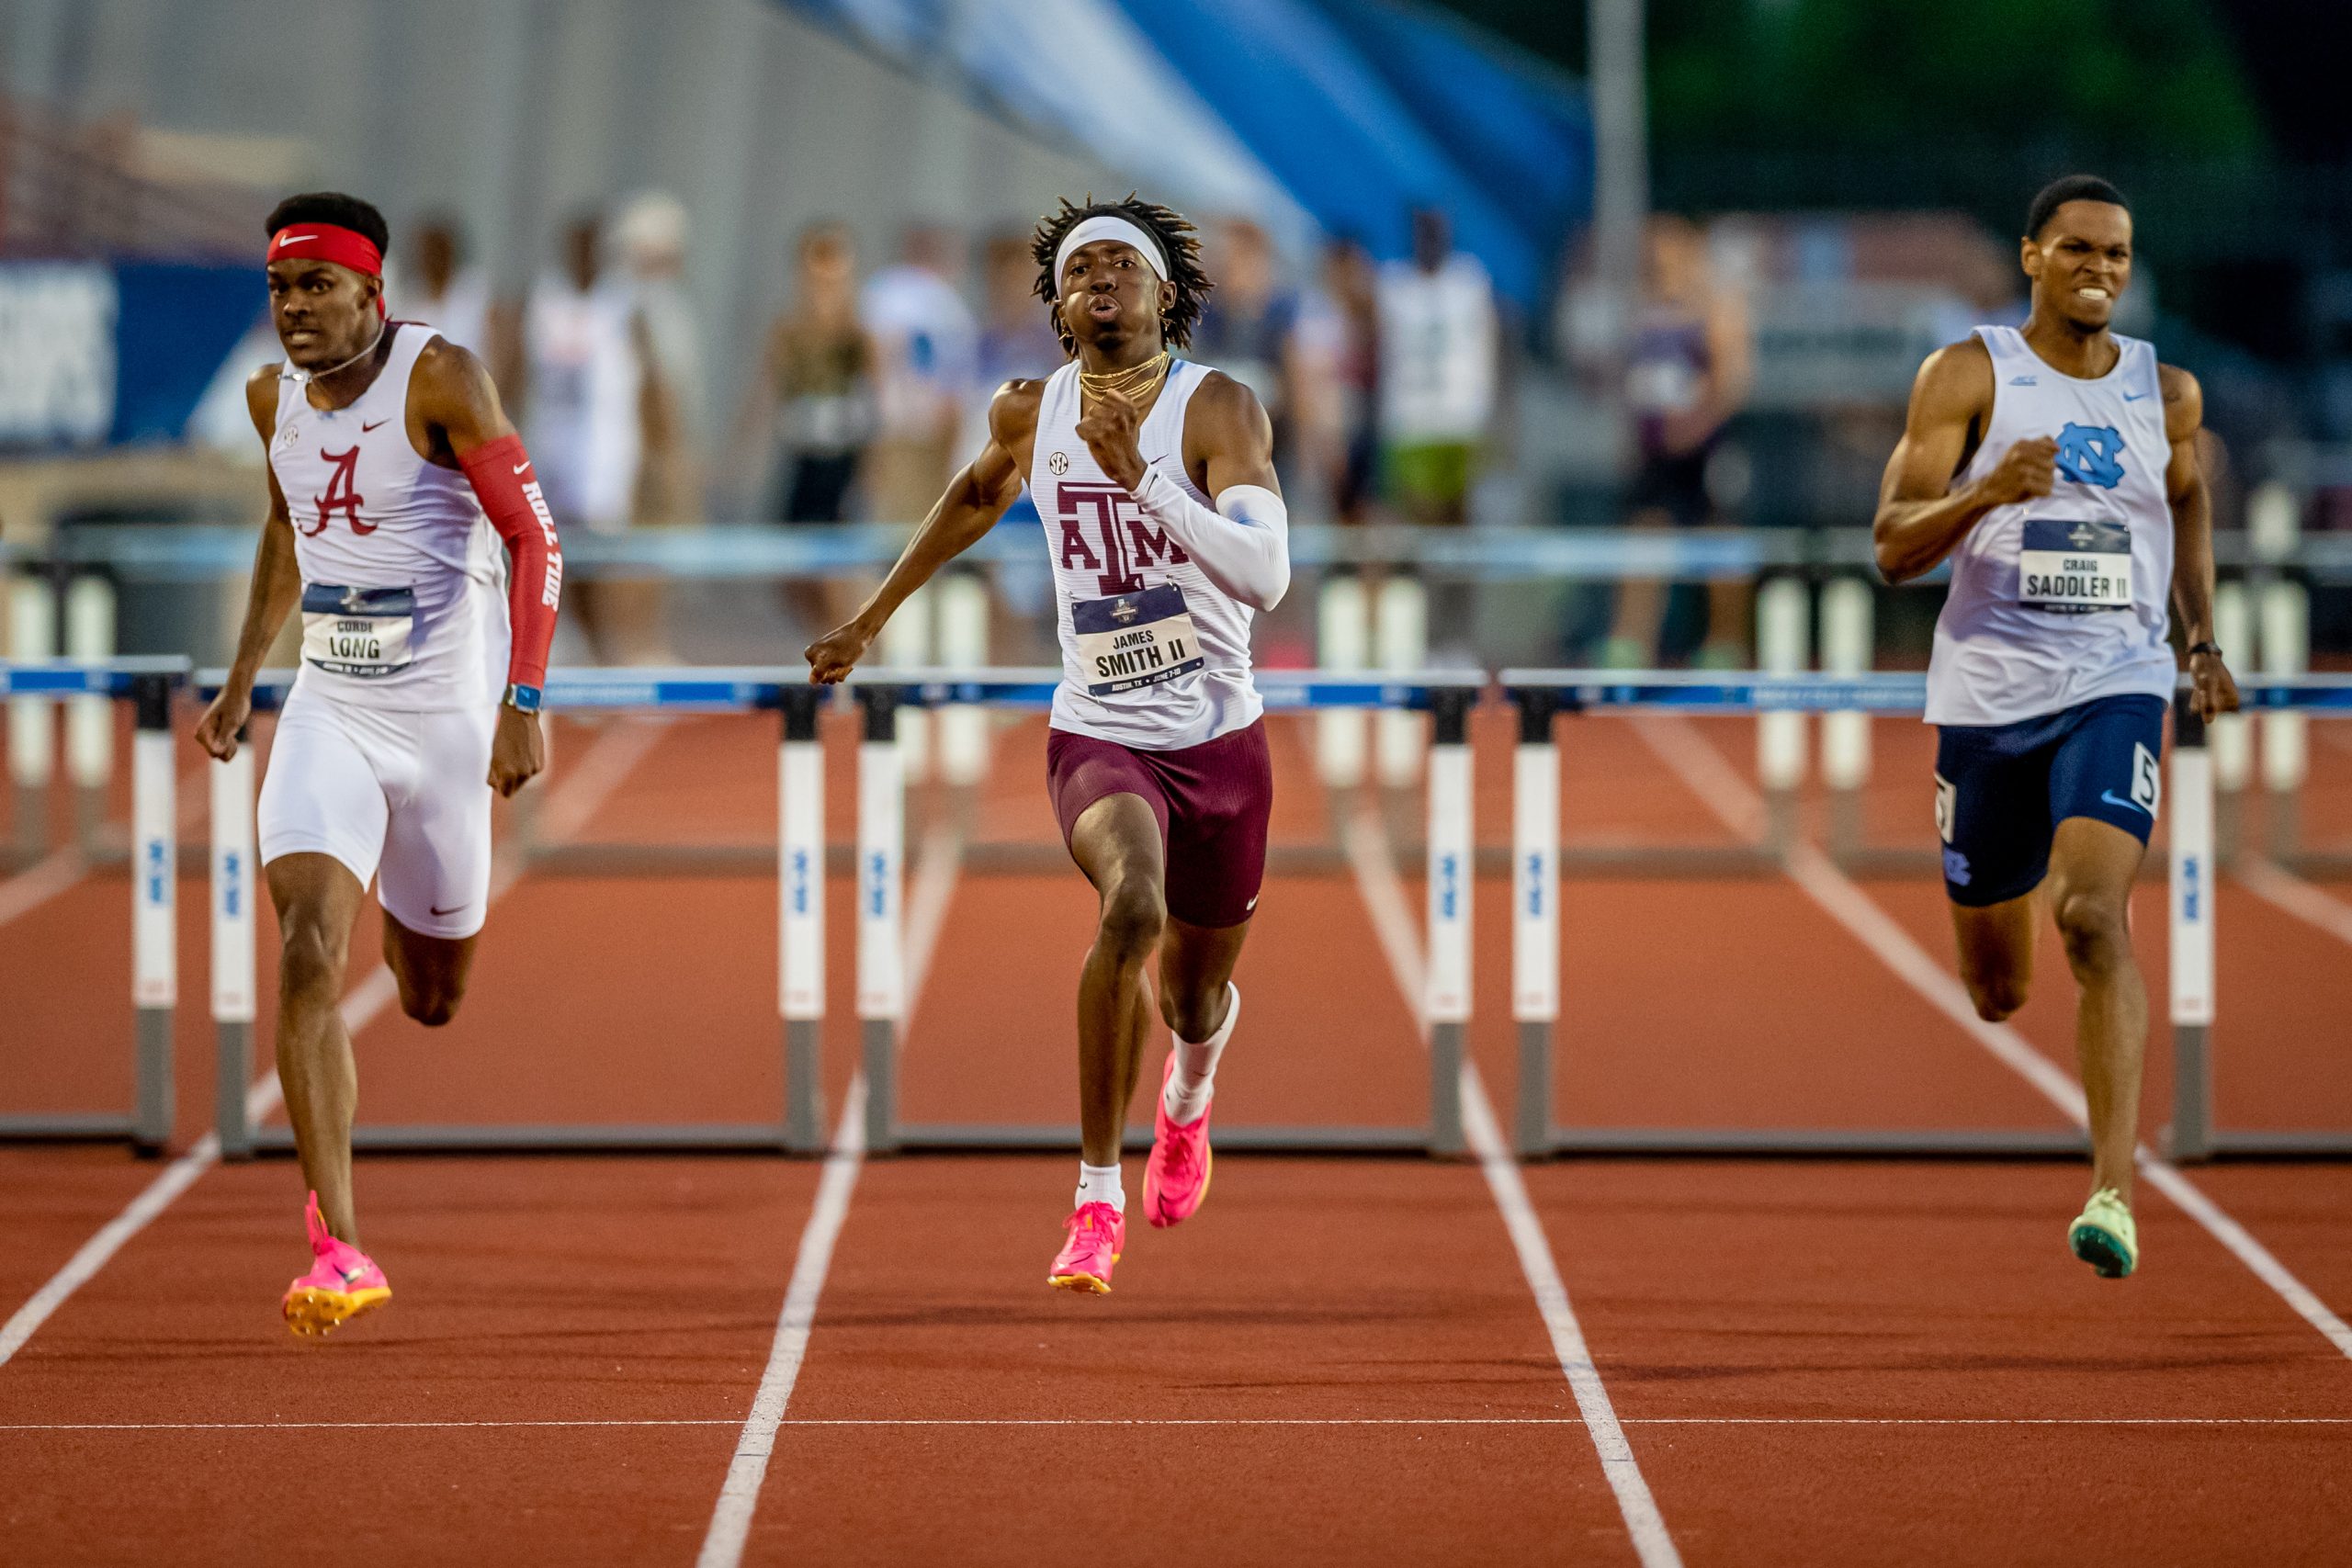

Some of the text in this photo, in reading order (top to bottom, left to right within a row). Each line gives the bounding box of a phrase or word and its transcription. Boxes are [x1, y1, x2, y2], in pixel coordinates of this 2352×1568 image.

[1049, 452, 1069, 475] SEC
[296, 445, 379, 537] A
[522, 480, 563, 612] ROLL TIDE
[2064, 558, 2098, 571] CRAIG
[2027, 575, 2127, 598] SADDLER II
[330, 636, 380, 659] LONG
[1113, 629, 1154, 649] JAMES
[1095, 638, 1186, 678] SMITH II
[2140, 754, 2154, 806] 5
